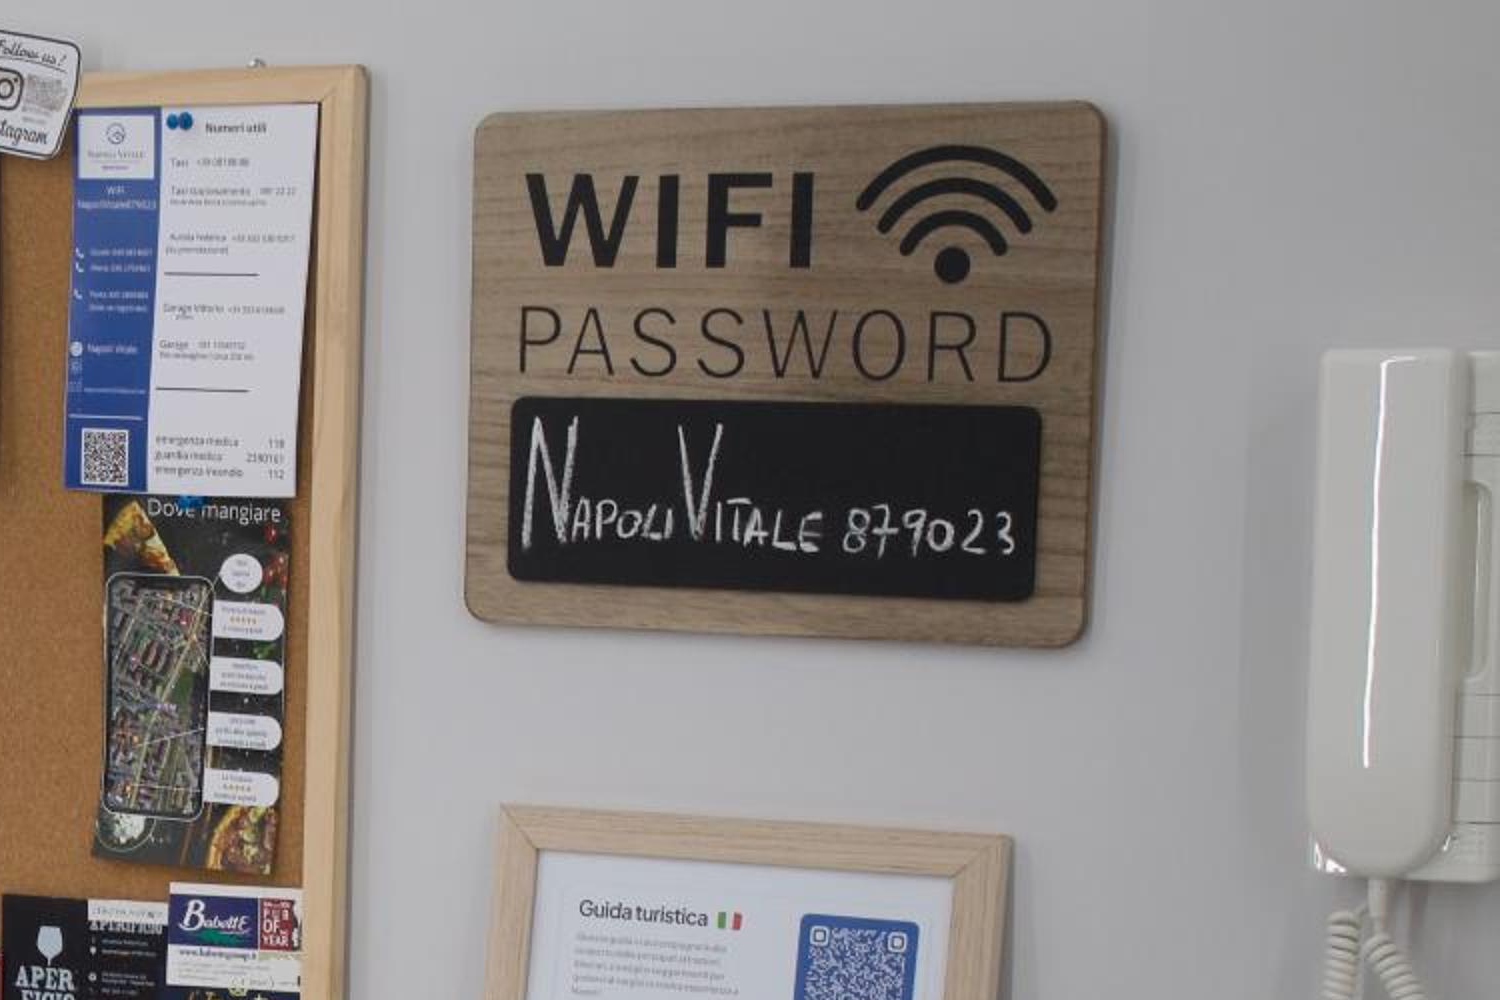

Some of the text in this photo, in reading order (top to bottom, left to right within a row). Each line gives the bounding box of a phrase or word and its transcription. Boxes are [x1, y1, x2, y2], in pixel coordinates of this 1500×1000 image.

[205, 122, 241, 134] Numeri
[525, 171, 815, 269] WIFI
[519, 304, 1053, 384] PASSWORD
[201, 504, 281, 526] mangiare
[843, 503, 1015, 559] 879023
[262, 919, 279, 932] OF
[579, 899, 709, 928] Guida turistica
[262, 934, 289, 948] YEAR
[15, 964, 75, 992] APER
